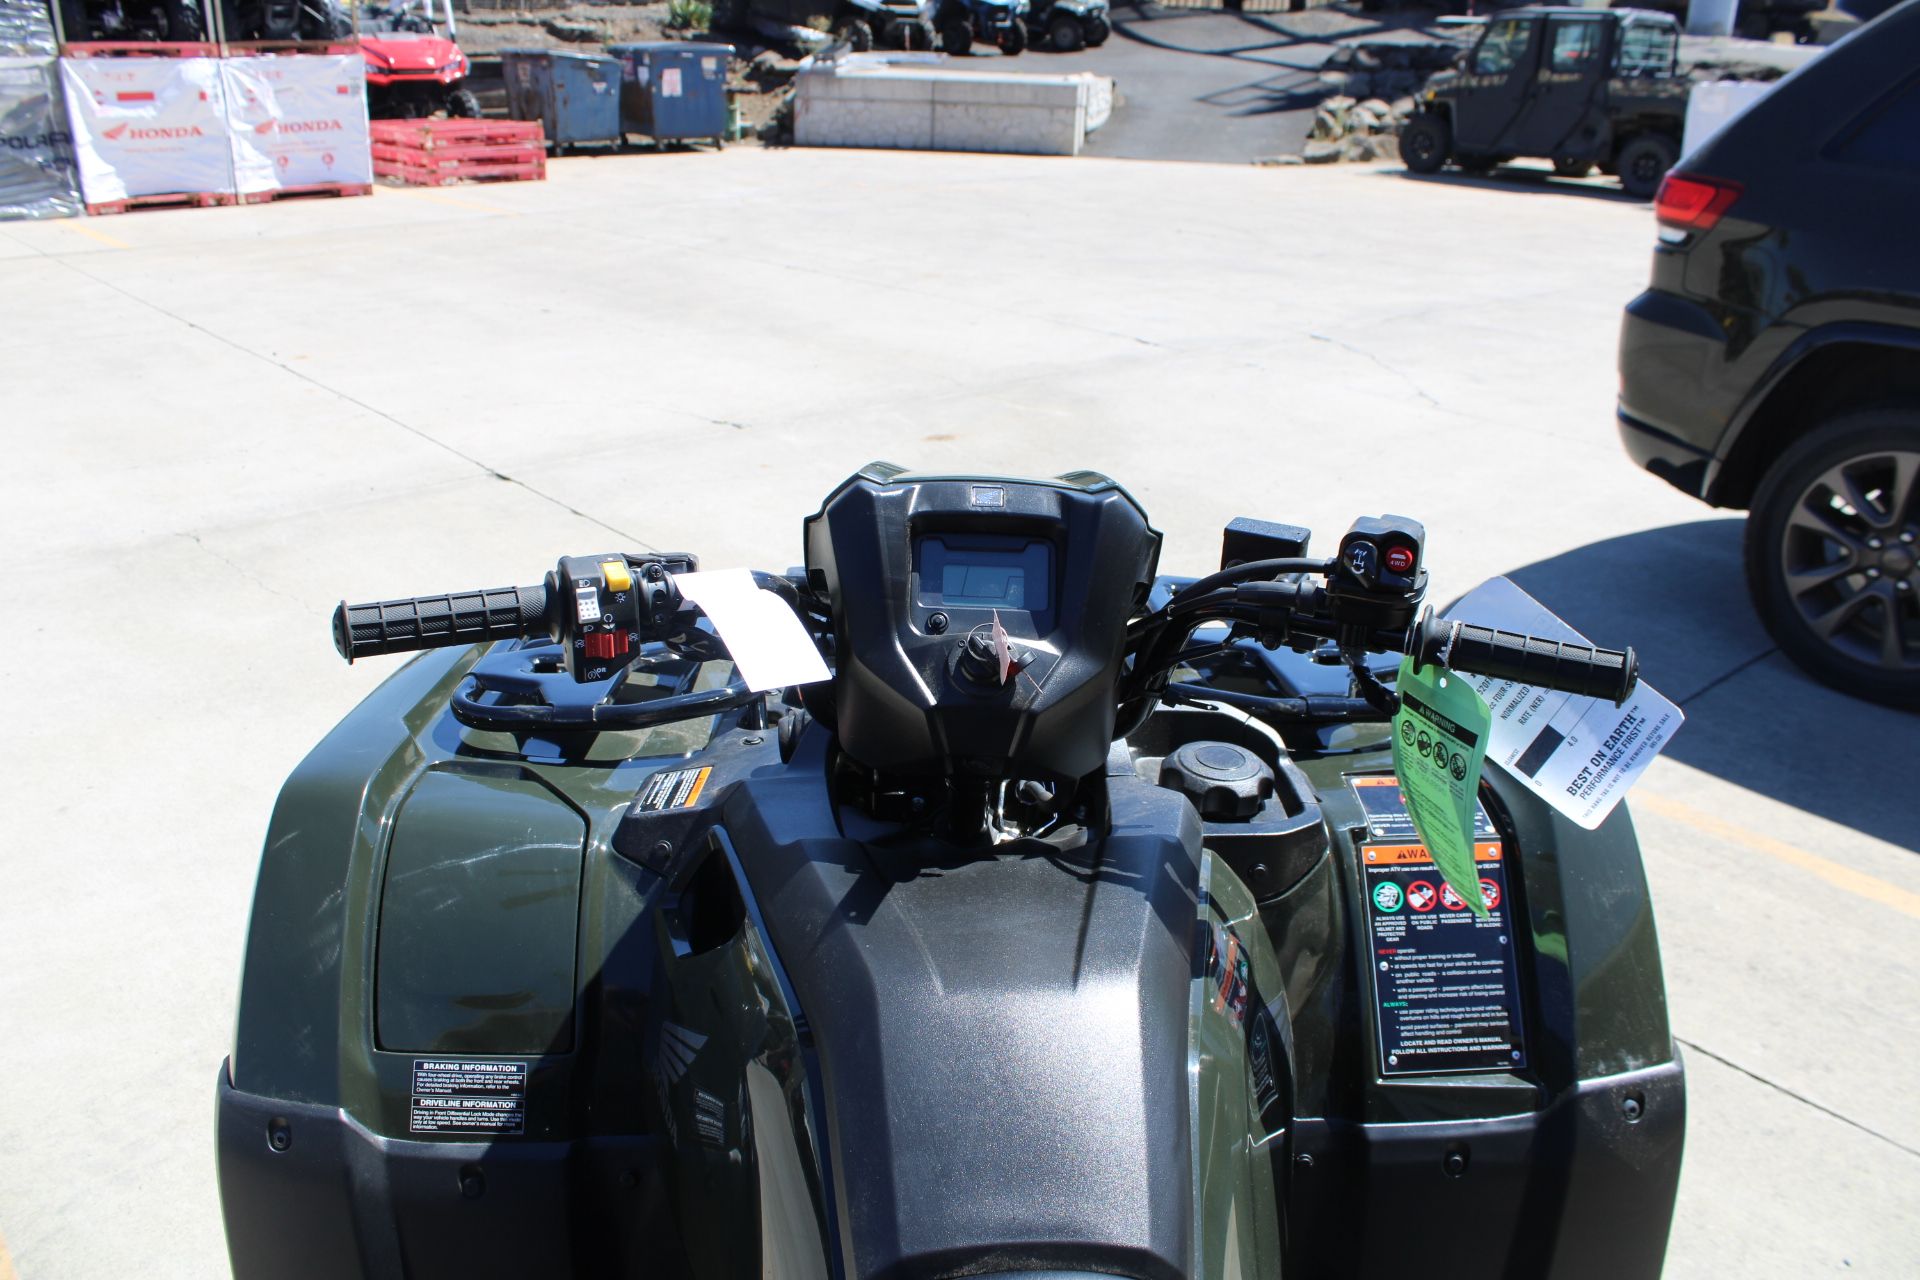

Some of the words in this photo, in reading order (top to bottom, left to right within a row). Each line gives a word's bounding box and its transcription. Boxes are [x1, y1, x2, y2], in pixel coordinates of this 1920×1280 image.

[129, 126, 203, 140] HONDA
[277, 120, 343, 134] HONDA
[1500, 686, 1530, 720] NORMALIZED
[1425, 707, 1456, 733] WARNING
[1518, 710, 1532, 725] RATE
[1567, 736, 1579, 748] 4.0
[1566, 766, 1594, 797] BEST
[1590, 749, 1607, 768] ON
[1579, 746, 1625, 800] PERFORMANCE
[423, 1063, 460, 1071] BRAKING
[462, 1064, 517, 1072] INFORMATION
[420, 1099, 460, 1107] DRIVELINE
[462, 1100, 516, 1109] INFORMATION
